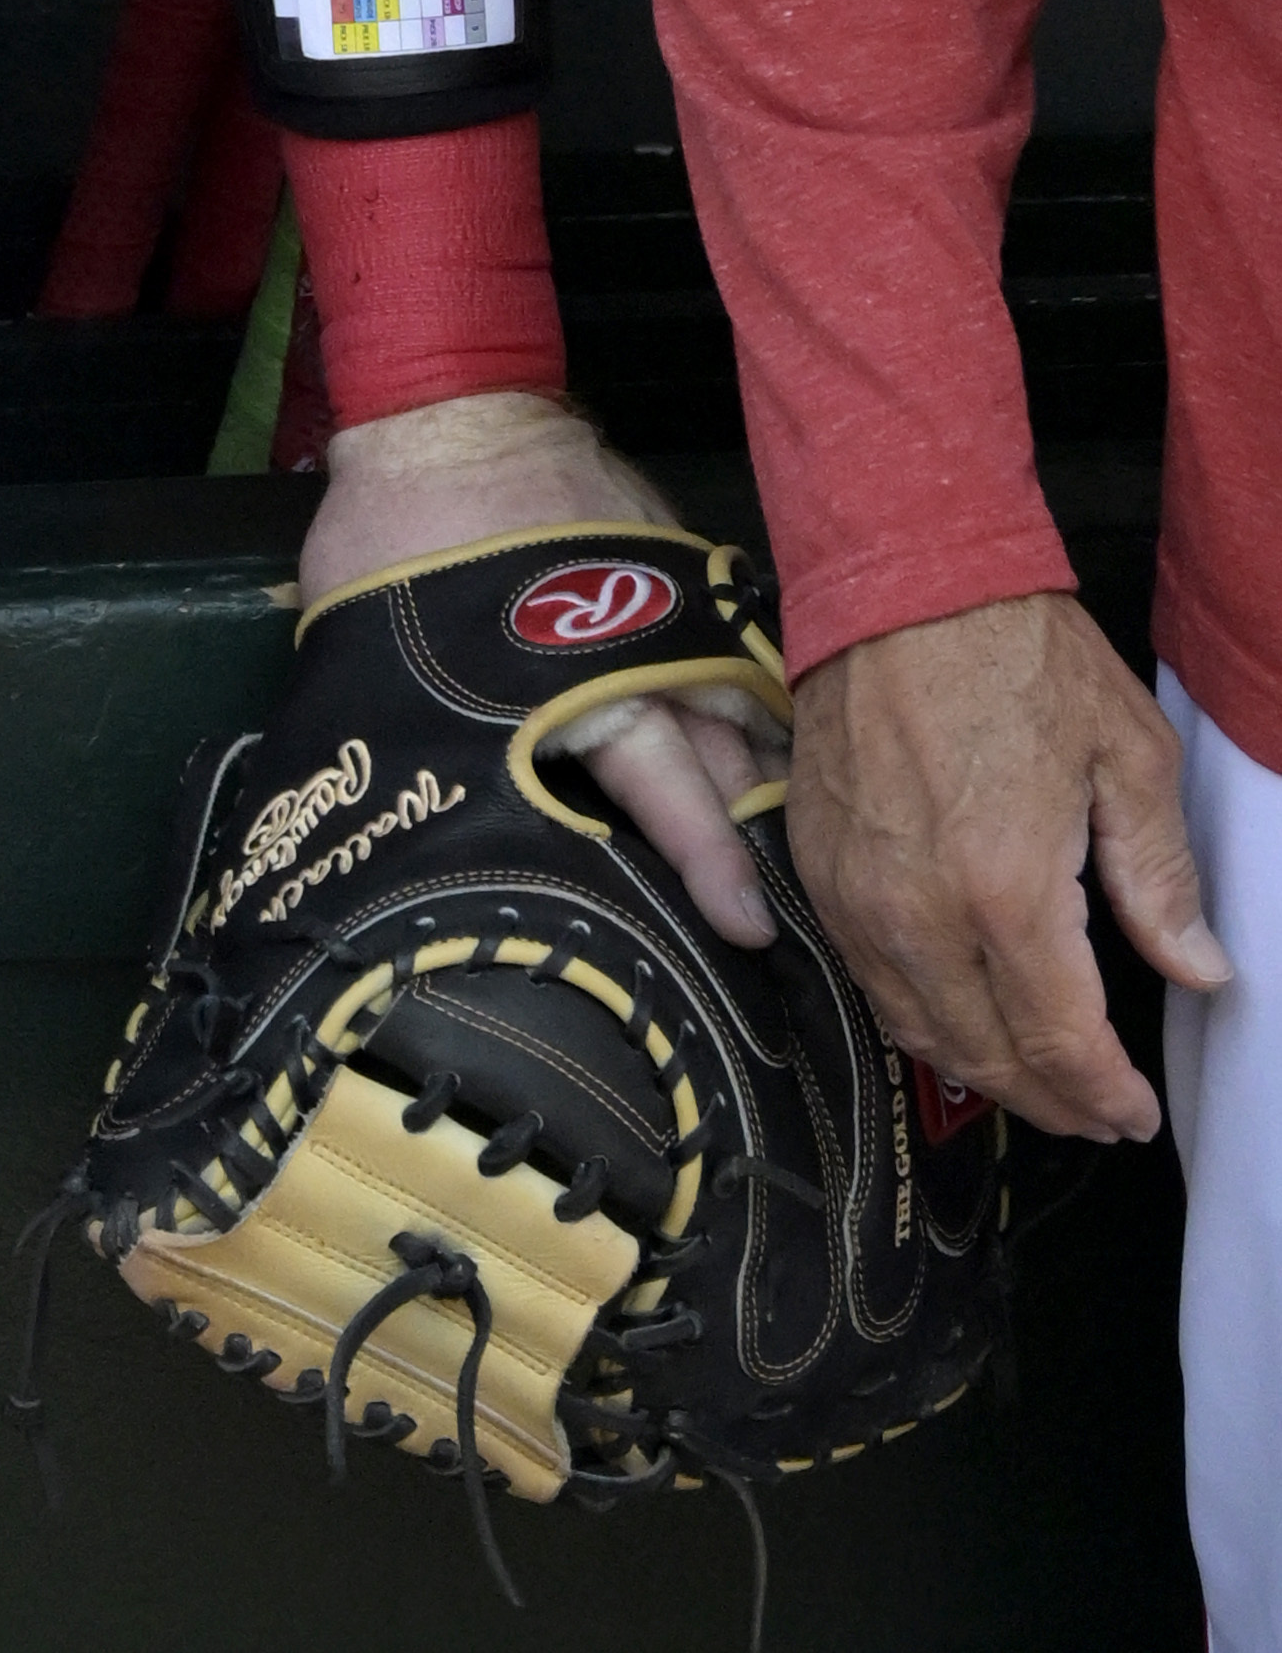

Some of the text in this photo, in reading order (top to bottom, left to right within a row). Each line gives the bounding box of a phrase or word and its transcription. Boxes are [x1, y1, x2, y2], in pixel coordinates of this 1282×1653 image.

[209, 737, 372, 935] Rawlings
[258, 769, 467, 924] Wallach
[872, 1010, 912, 1248] THE GOLD GLO
